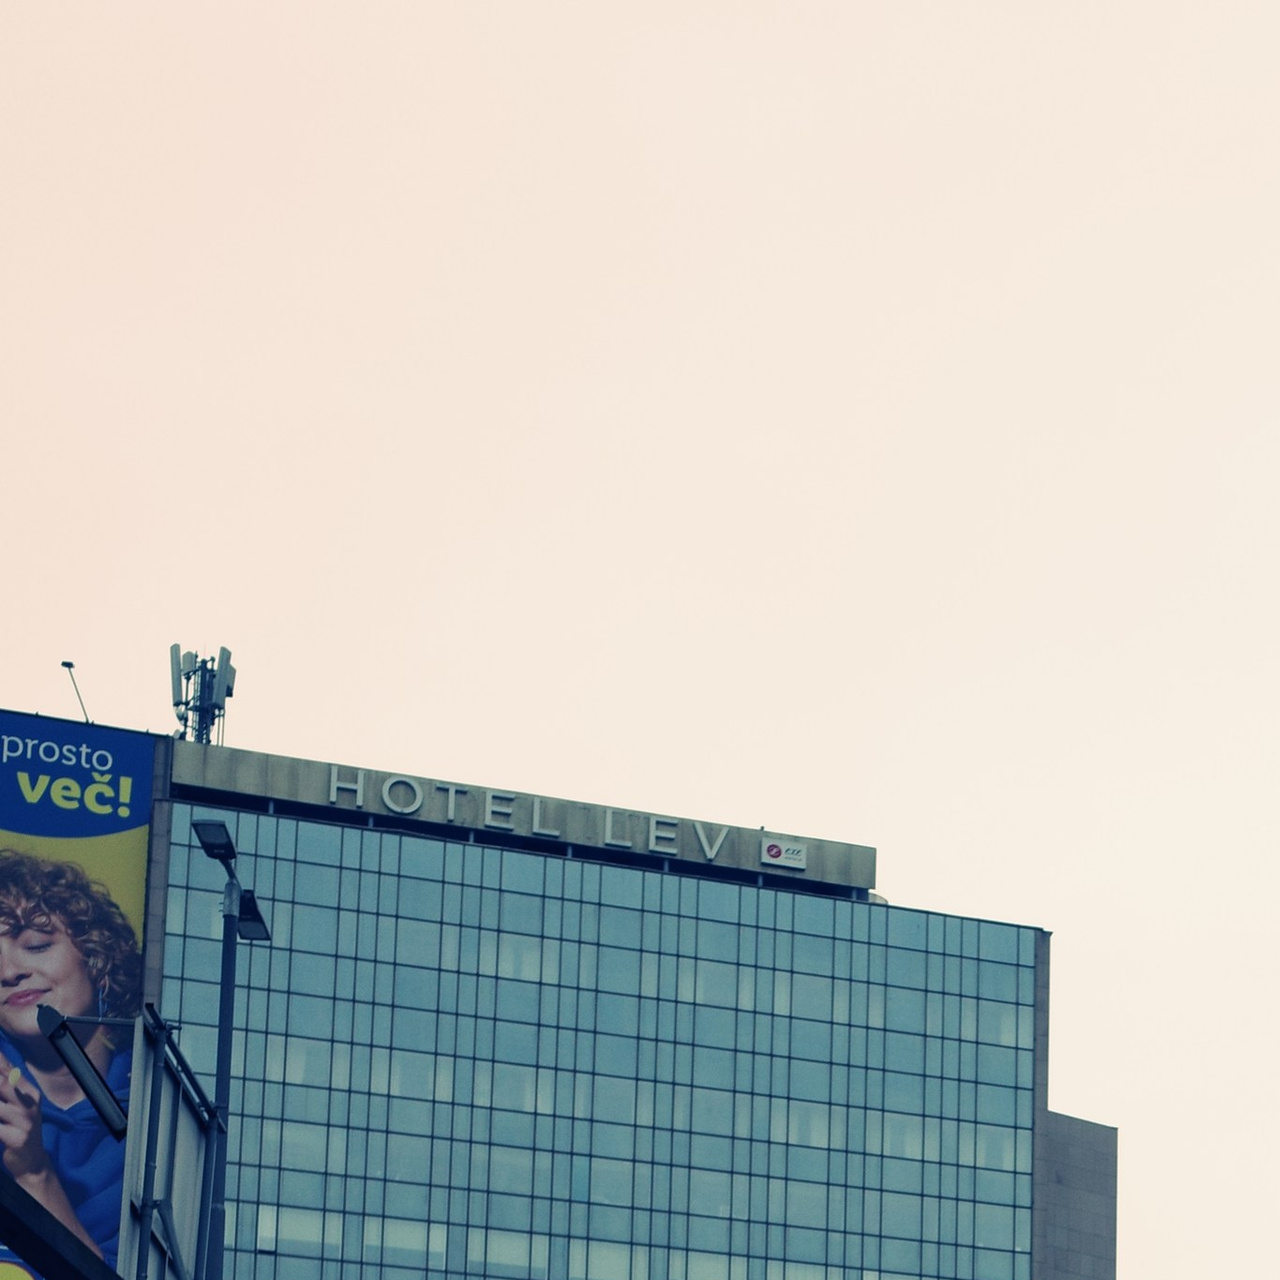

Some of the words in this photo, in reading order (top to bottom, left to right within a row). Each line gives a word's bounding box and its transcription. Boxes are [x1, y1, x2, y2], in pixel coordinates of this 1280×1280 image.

[1, 735, 113, 770] prosto
[16, 771, 132, 818] več!
[329, 765, 560, 837] HOTEL
[604, 808, 731, 862] LEV
